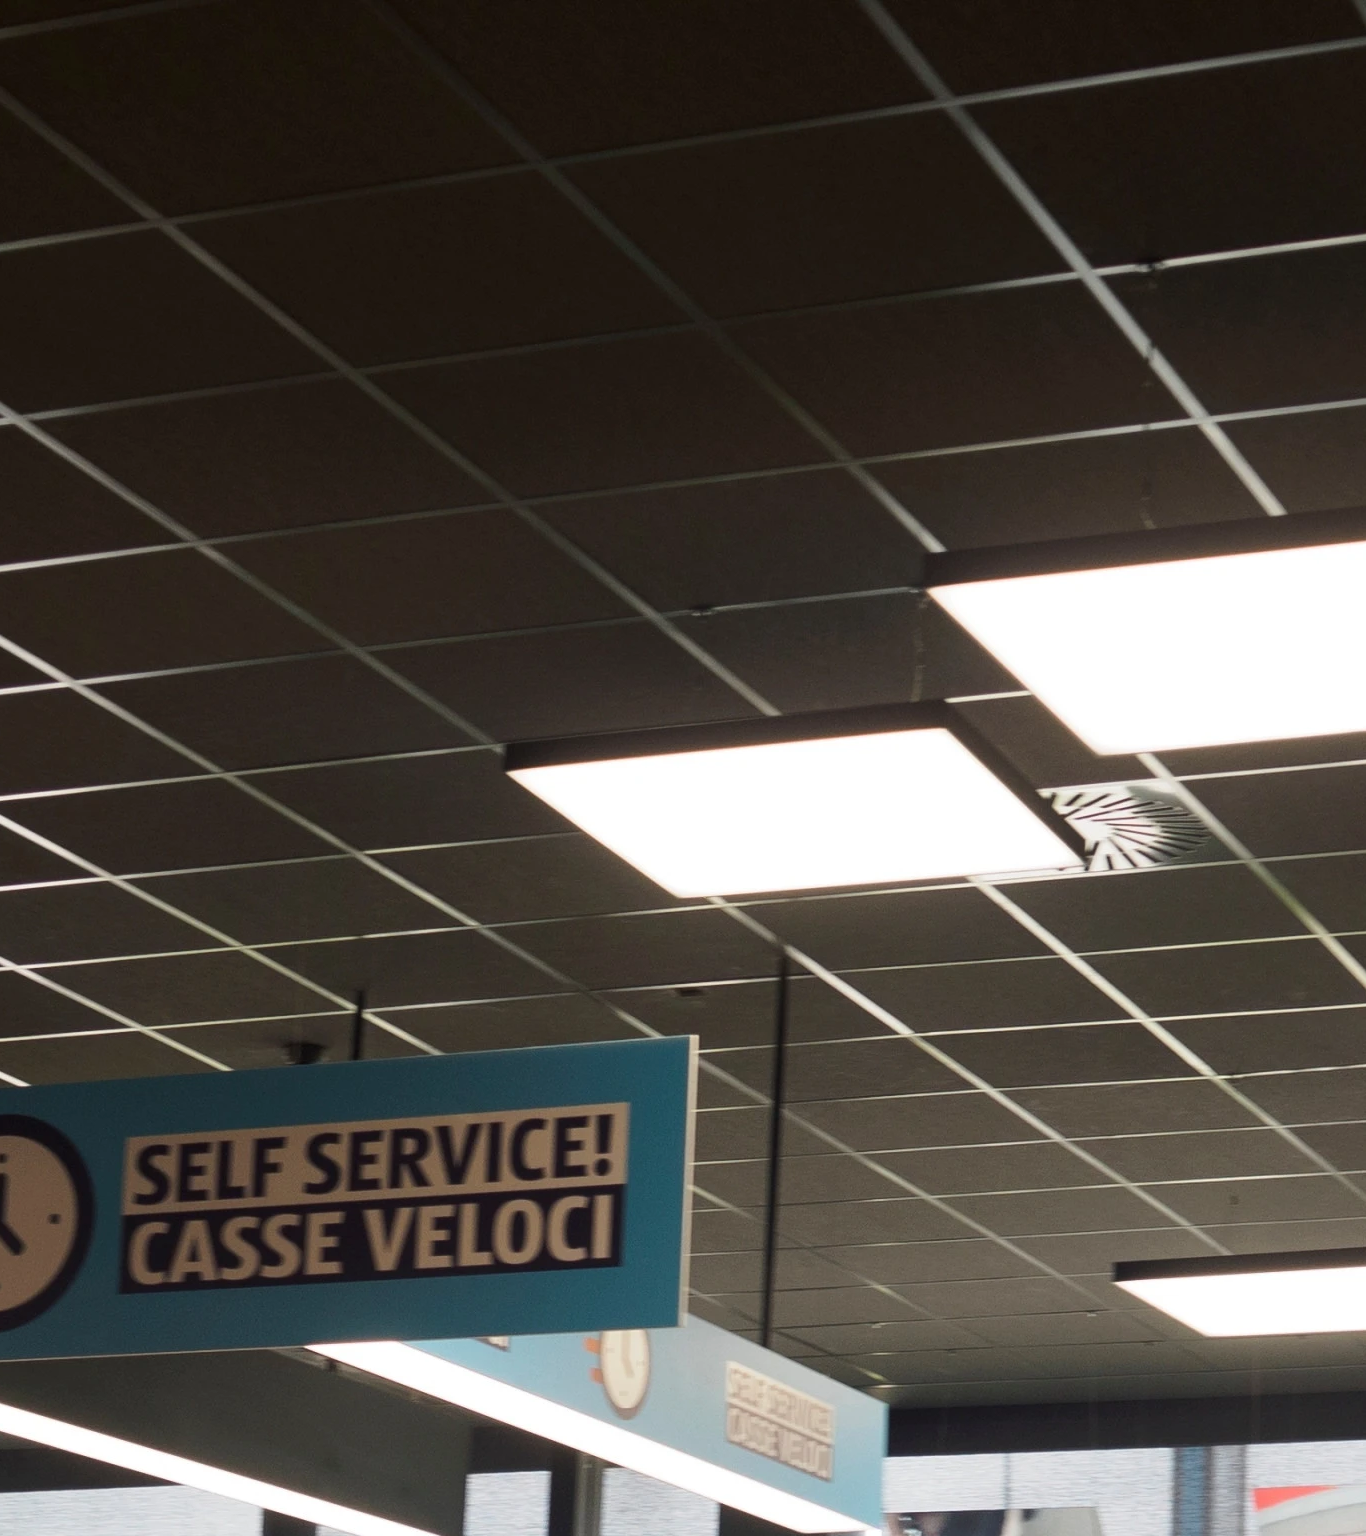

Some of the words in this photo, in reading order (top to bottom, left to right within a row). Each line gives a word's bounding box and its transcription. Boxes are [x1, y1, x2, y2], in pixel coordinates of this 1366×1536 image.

[134, 1136, 289, 1206] SELF
[303, 1113, 616, 1195] SERVICE!
[128, 1211, 346, 1286] CASSE
[362, 1194, 616, 1272] VELOCI
